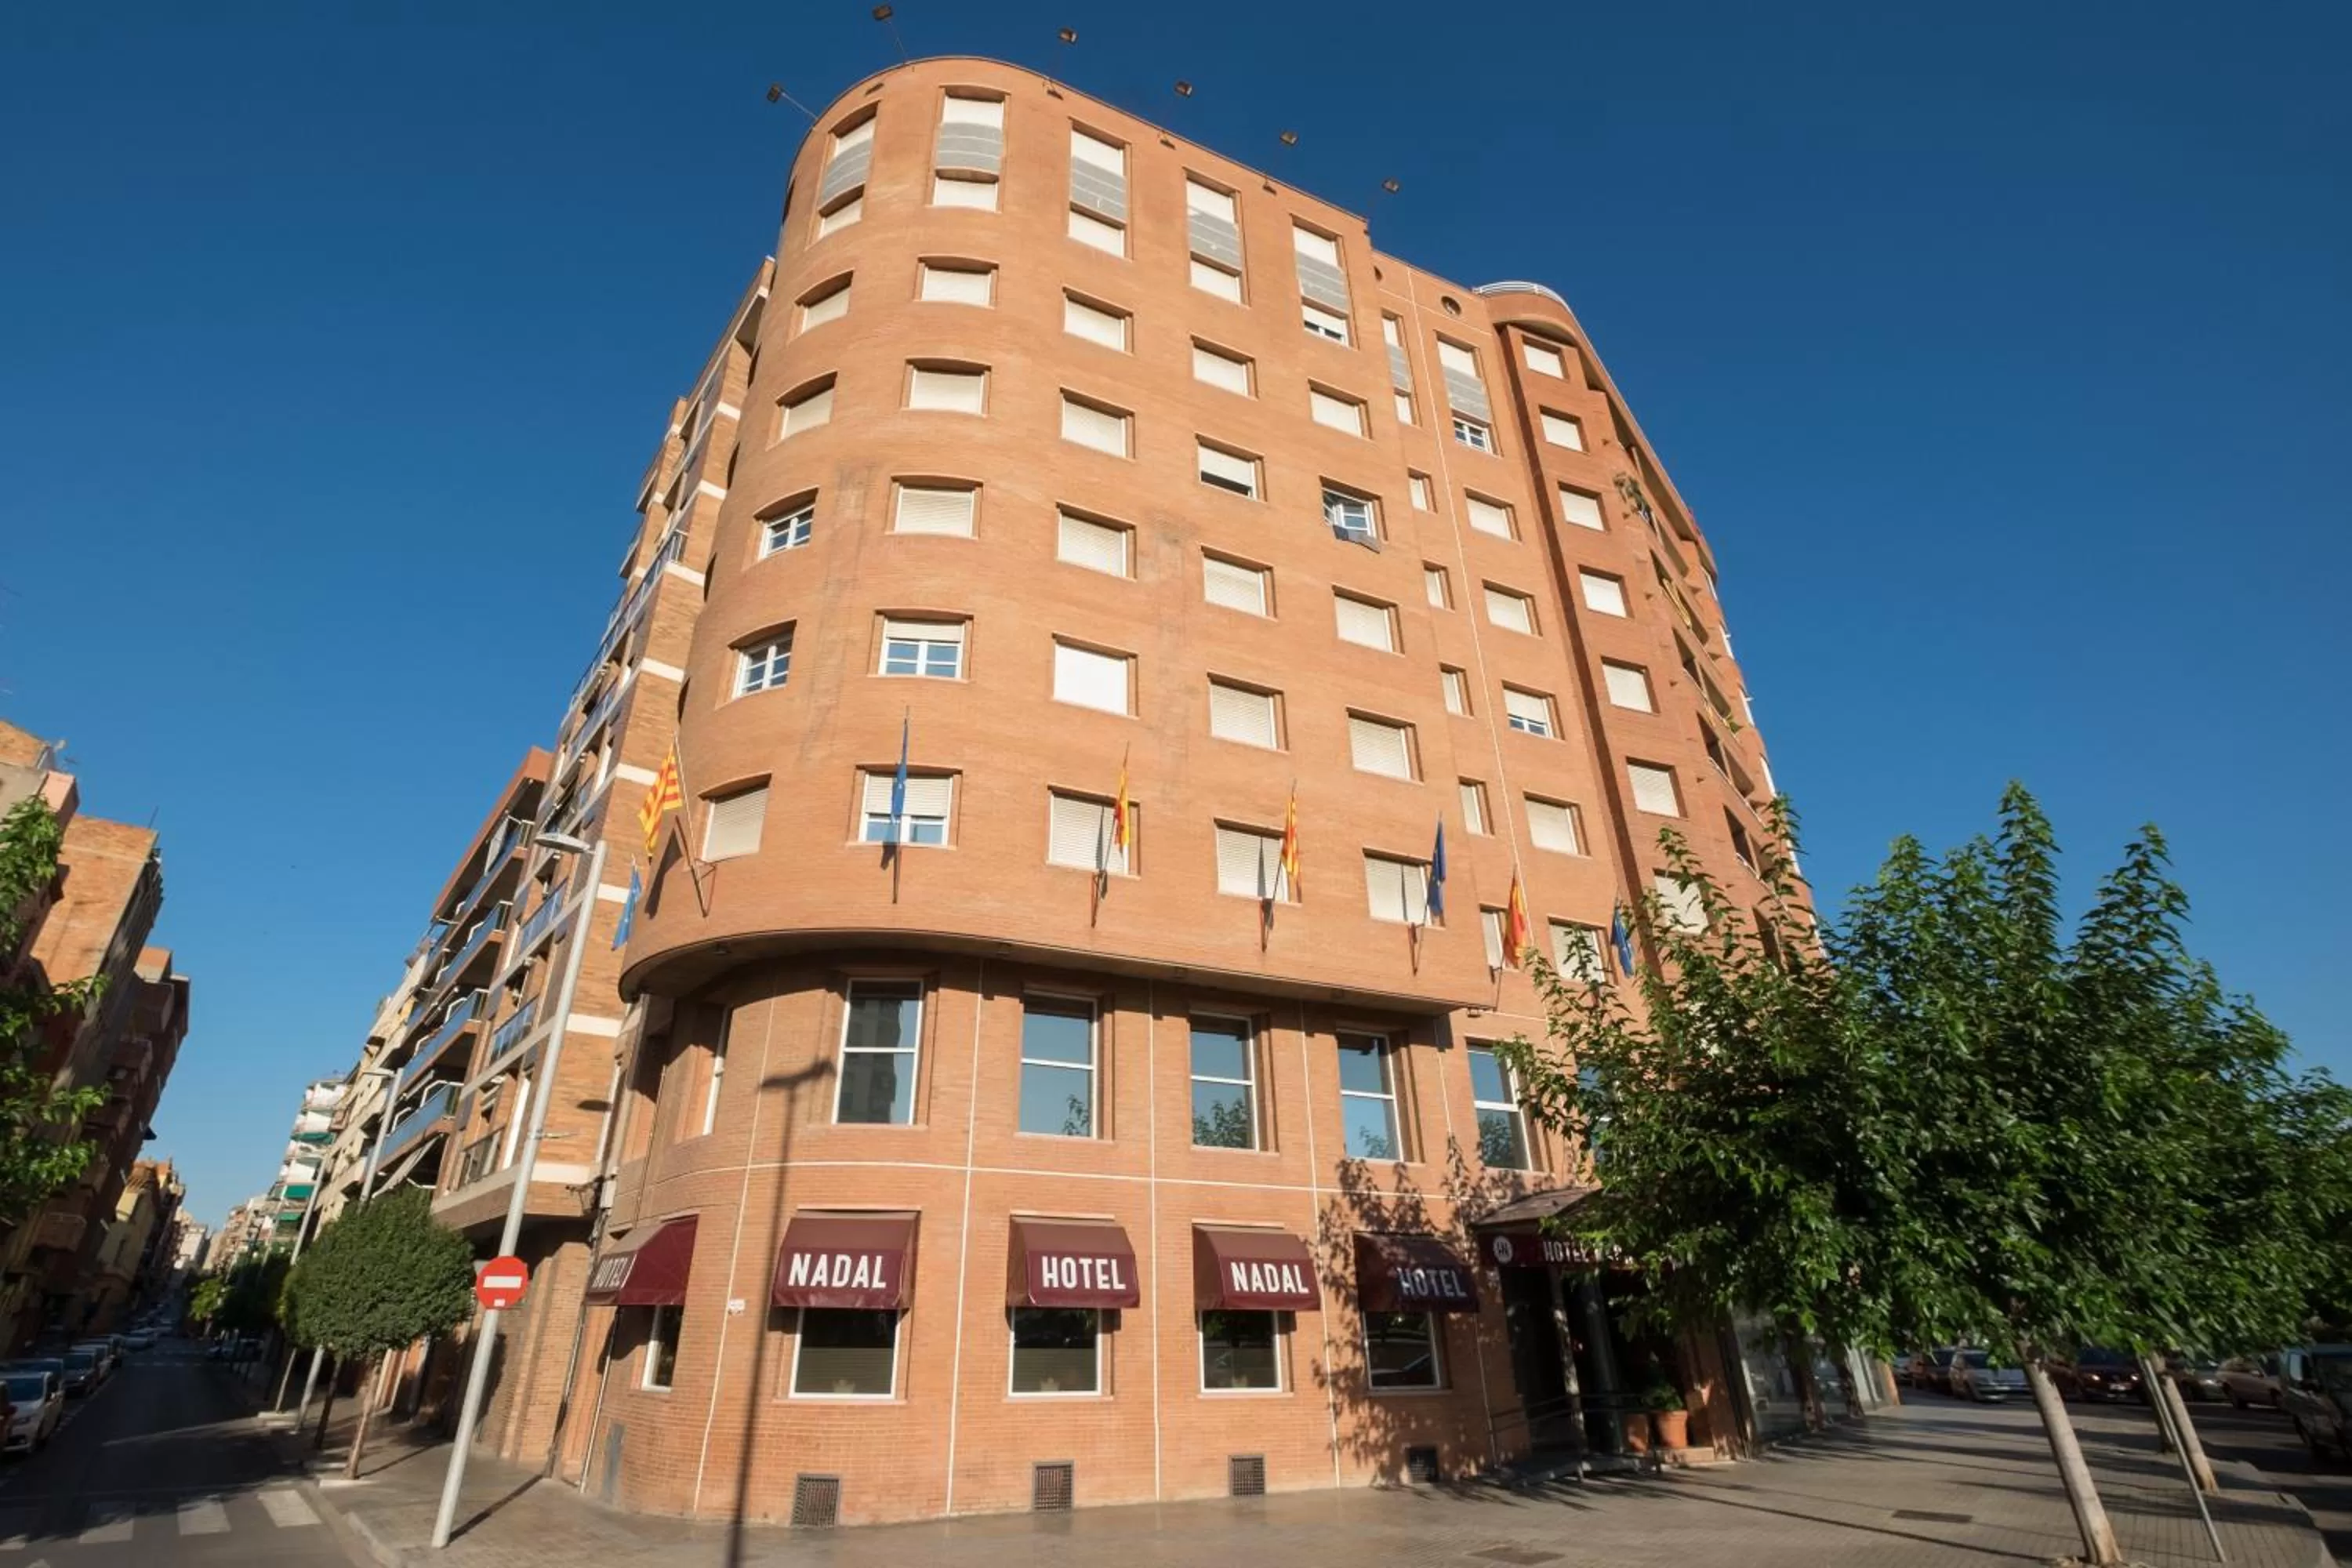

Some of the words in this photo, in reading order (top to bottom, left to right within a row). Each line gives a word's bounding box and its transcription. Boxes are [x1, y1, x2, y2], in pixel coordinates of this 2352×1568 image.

[1542, 1240, 1589, 1263] HOTEL
[592, 1257, 629, 1288] HOTEL
[788, 1252, 887, 1288] NADAL
[1041, 1255, 1126, 1290] HOTEL
[1230, 1261, 1309, 1294] NADAL
[1396, 1267, 1468, 1298] HOTEL
